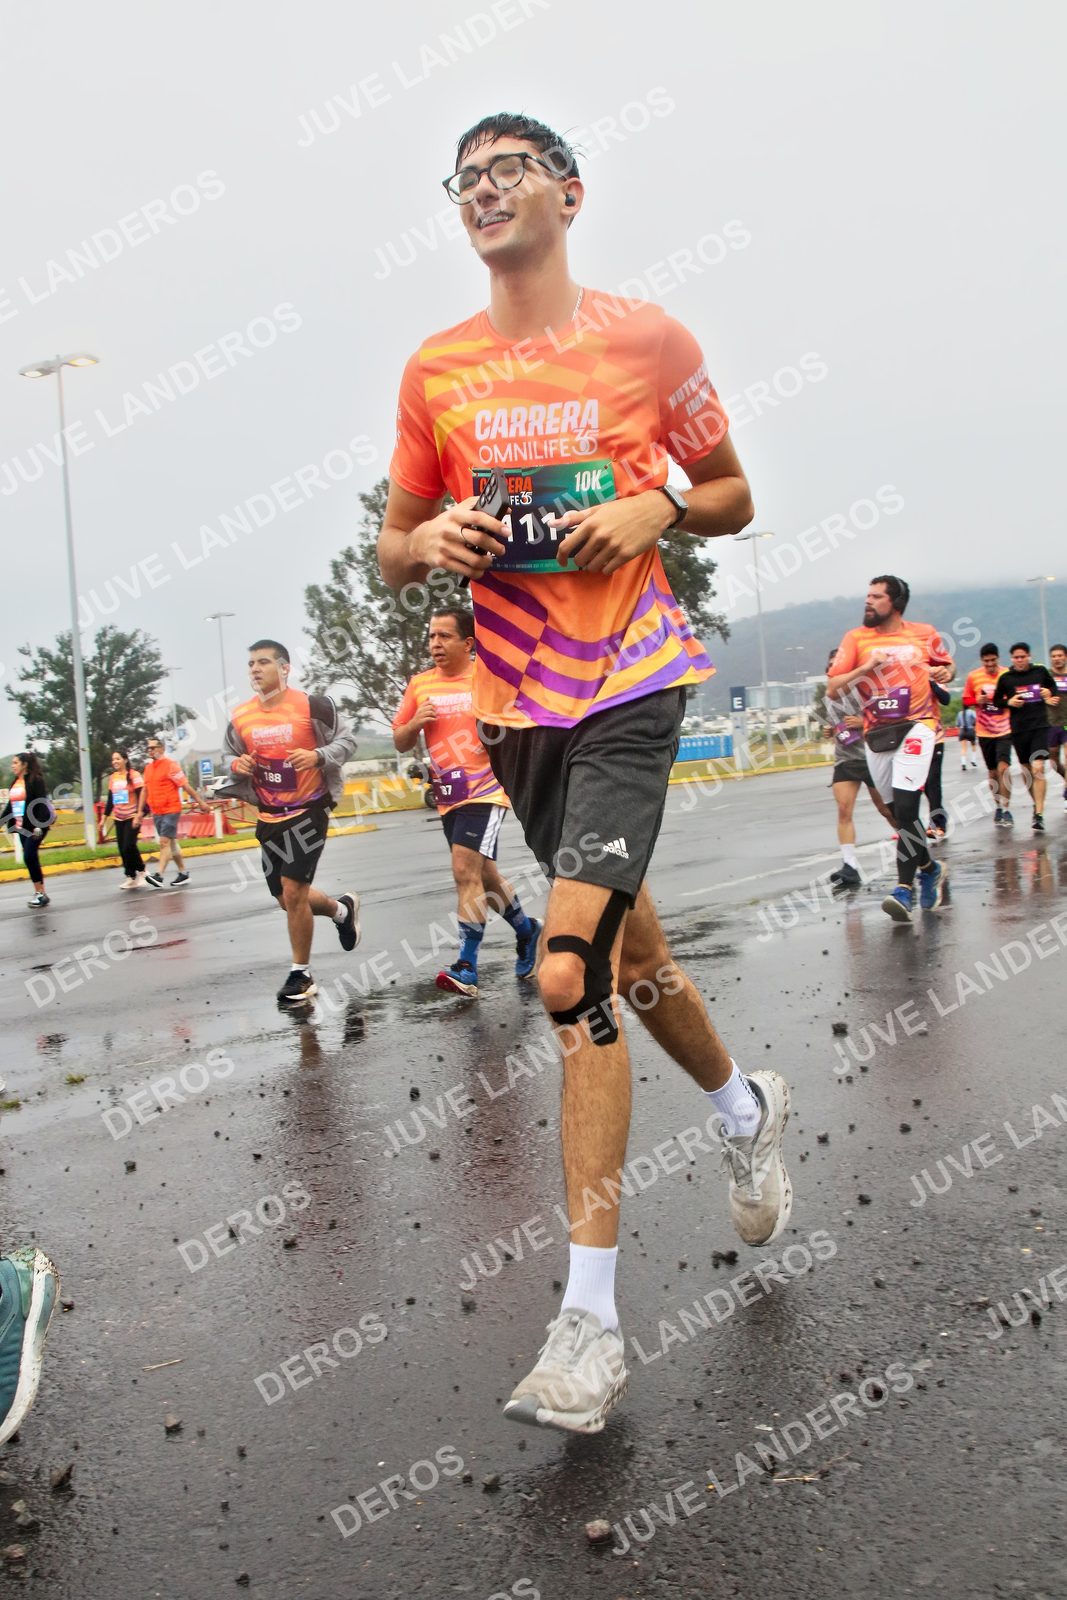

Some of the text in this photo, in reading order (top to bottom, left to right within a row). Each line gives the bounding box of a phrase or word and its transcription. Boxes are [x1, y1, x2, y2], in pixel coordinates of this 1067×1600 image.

[475, 399, 599, 441] CARRERA
[479, 438, 571, 464] OMNILIFE
[575, 469, 601, 492] 10K
[733, 697, 743, 709] E
[878, 700, 899, 709] 622
[264, 771, 282, 783] 188
[603, 845, 629, 859] adidas
